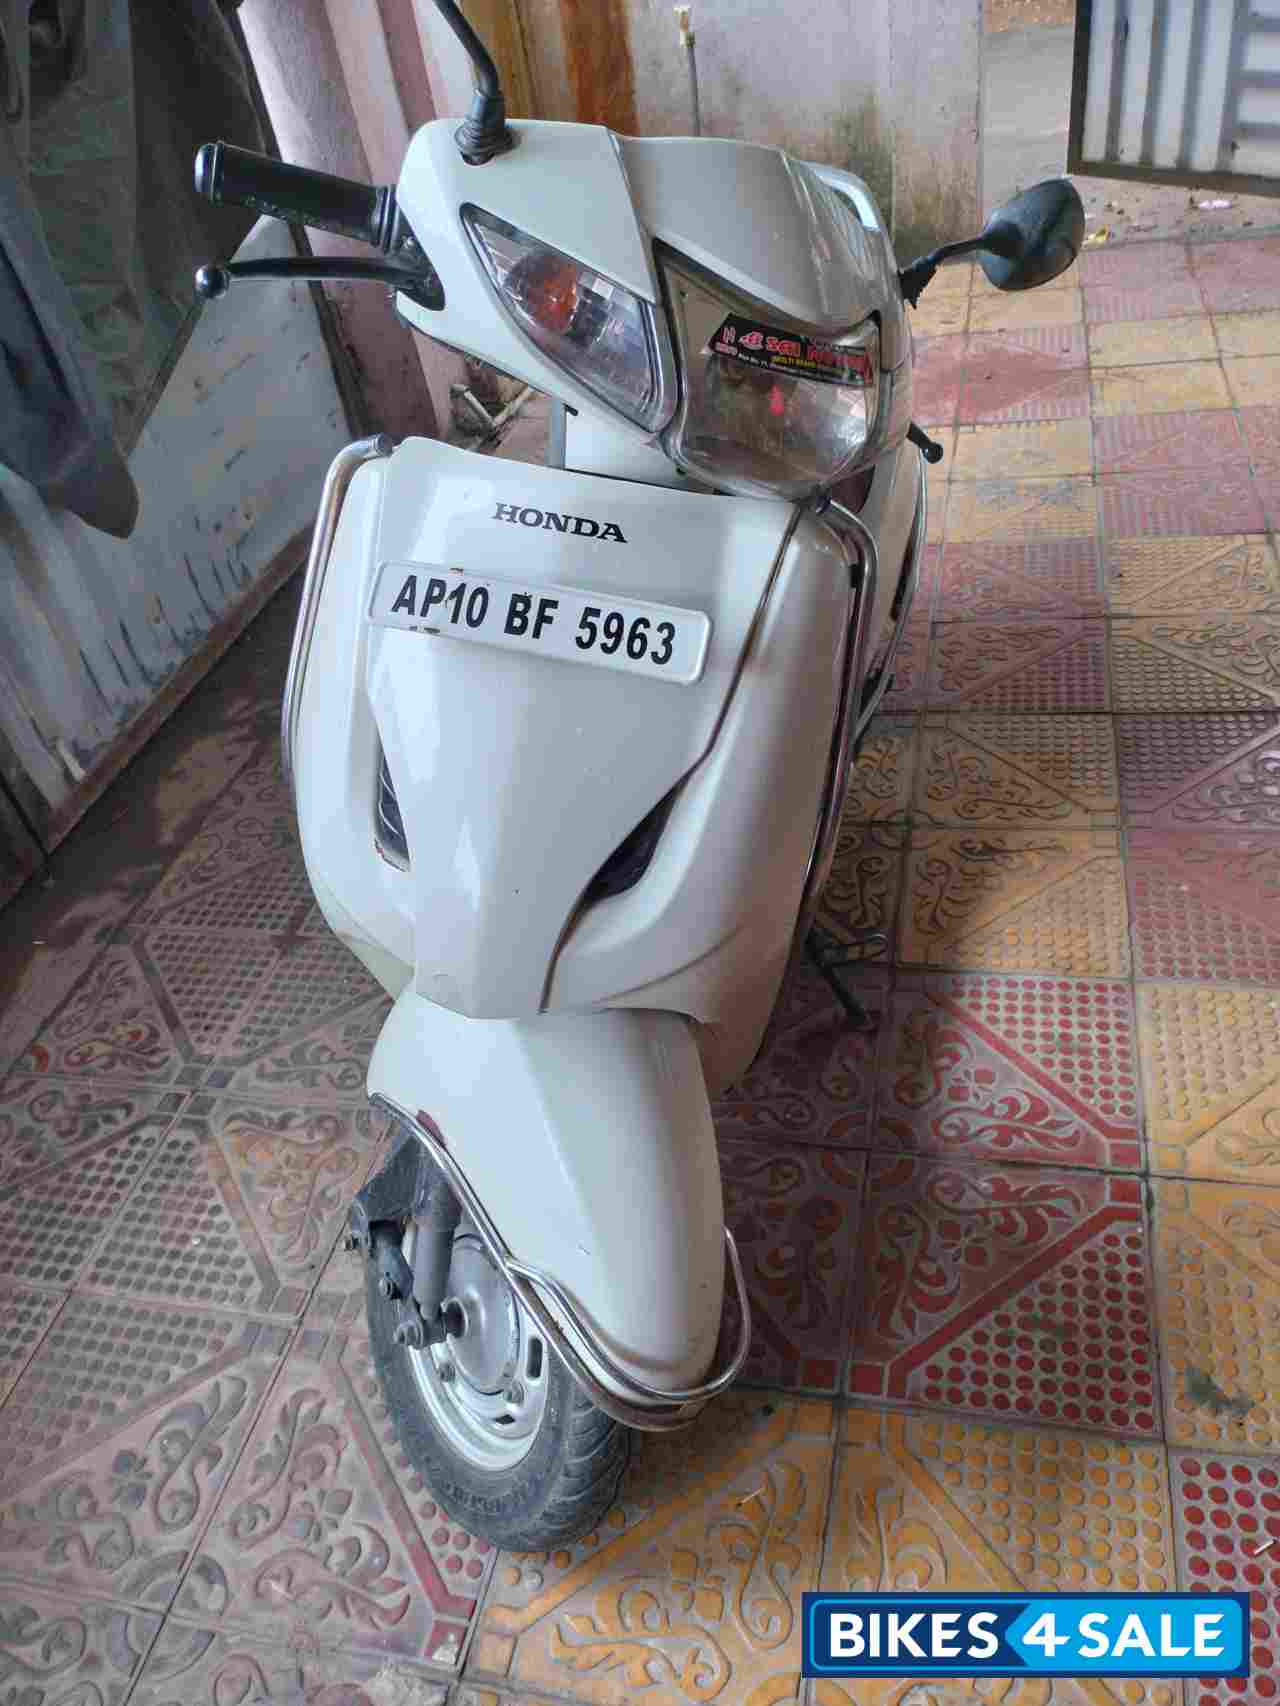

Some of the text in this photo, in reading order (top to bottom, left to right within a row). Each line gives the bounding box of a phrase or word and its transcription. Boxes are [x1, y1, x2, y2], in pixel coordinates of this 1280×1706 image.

[491, 502, 628, 544] HONDA
[391, 575, 676, 665] AP10 BF 5963
